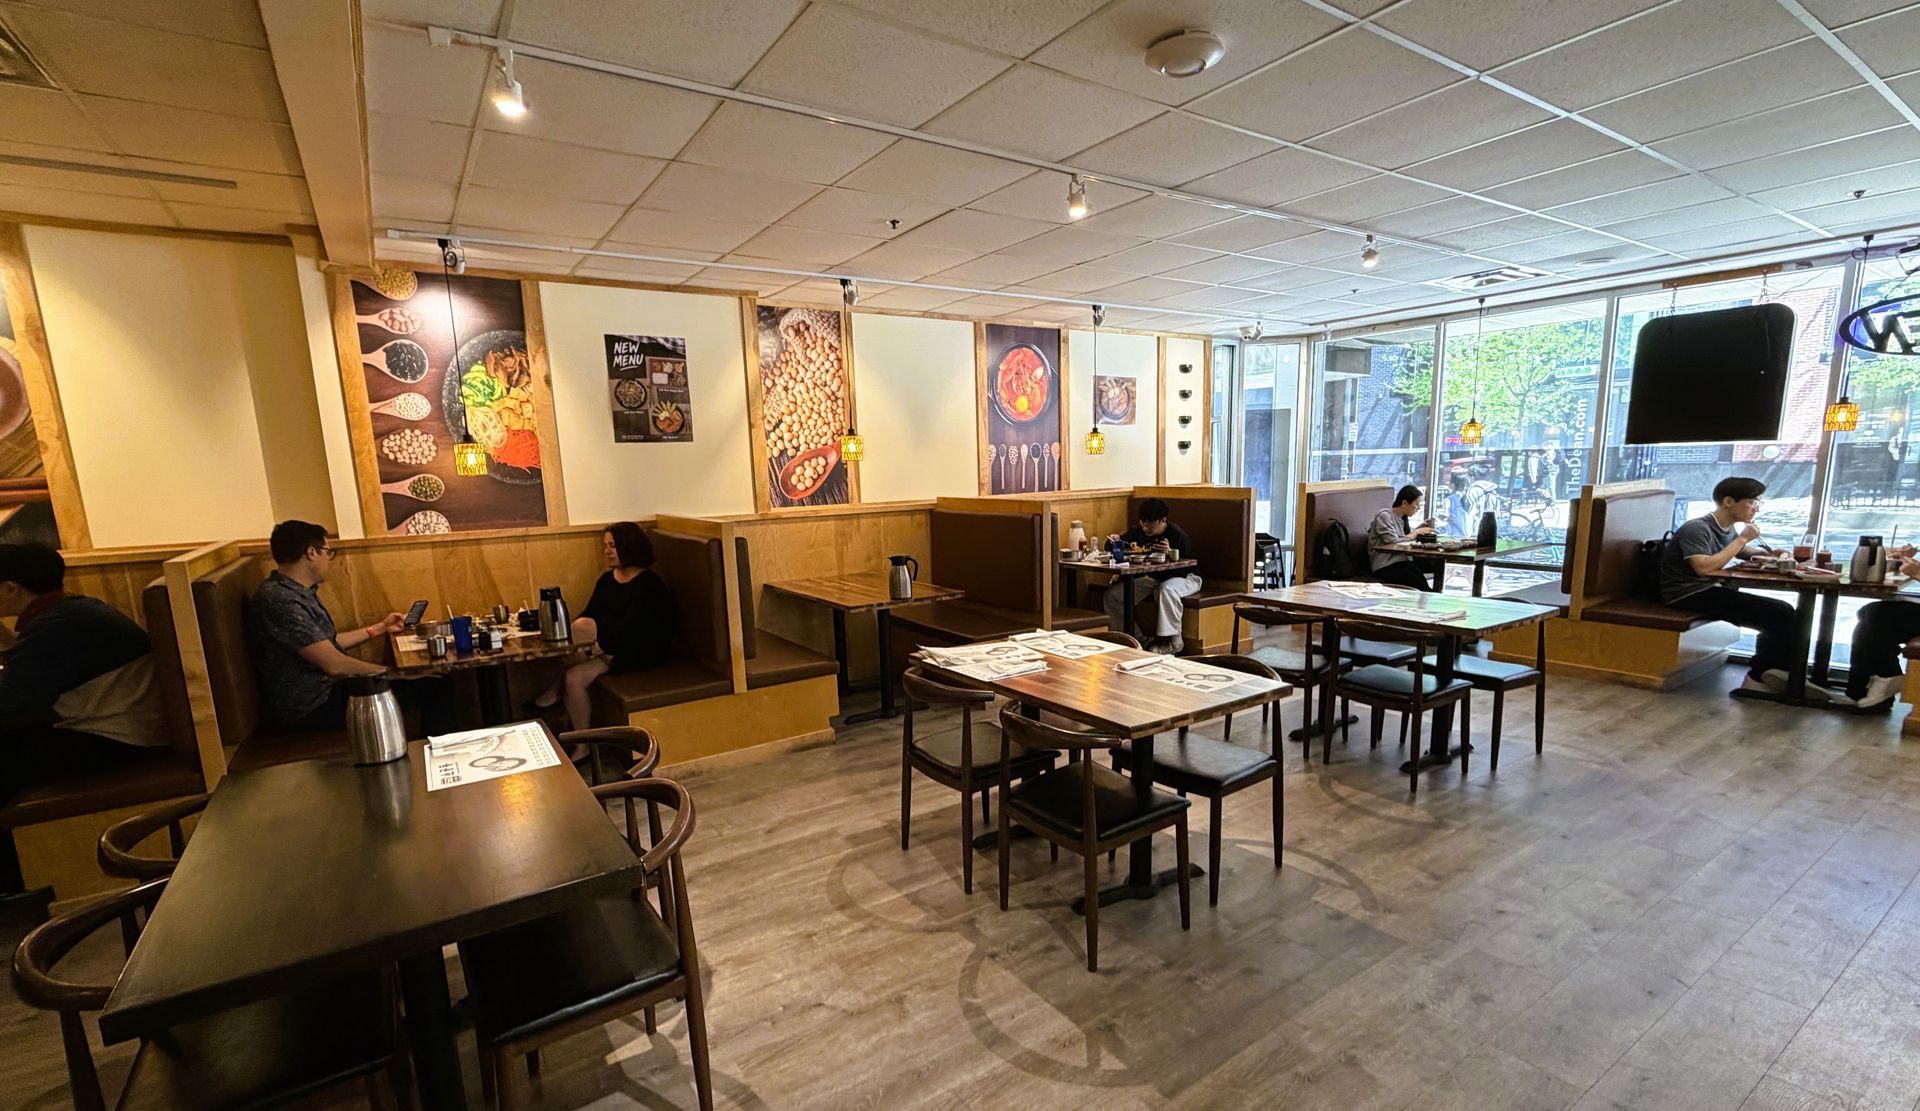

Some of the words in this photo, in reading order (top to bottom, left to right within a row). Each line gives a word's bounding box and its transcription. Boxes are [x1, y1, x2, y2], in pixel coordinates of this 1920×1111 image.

[614, 341, 640, 354] NEW
[613, 353, 643, 368] MENU
[1565, 398, 1588, 495] TheDean.com
